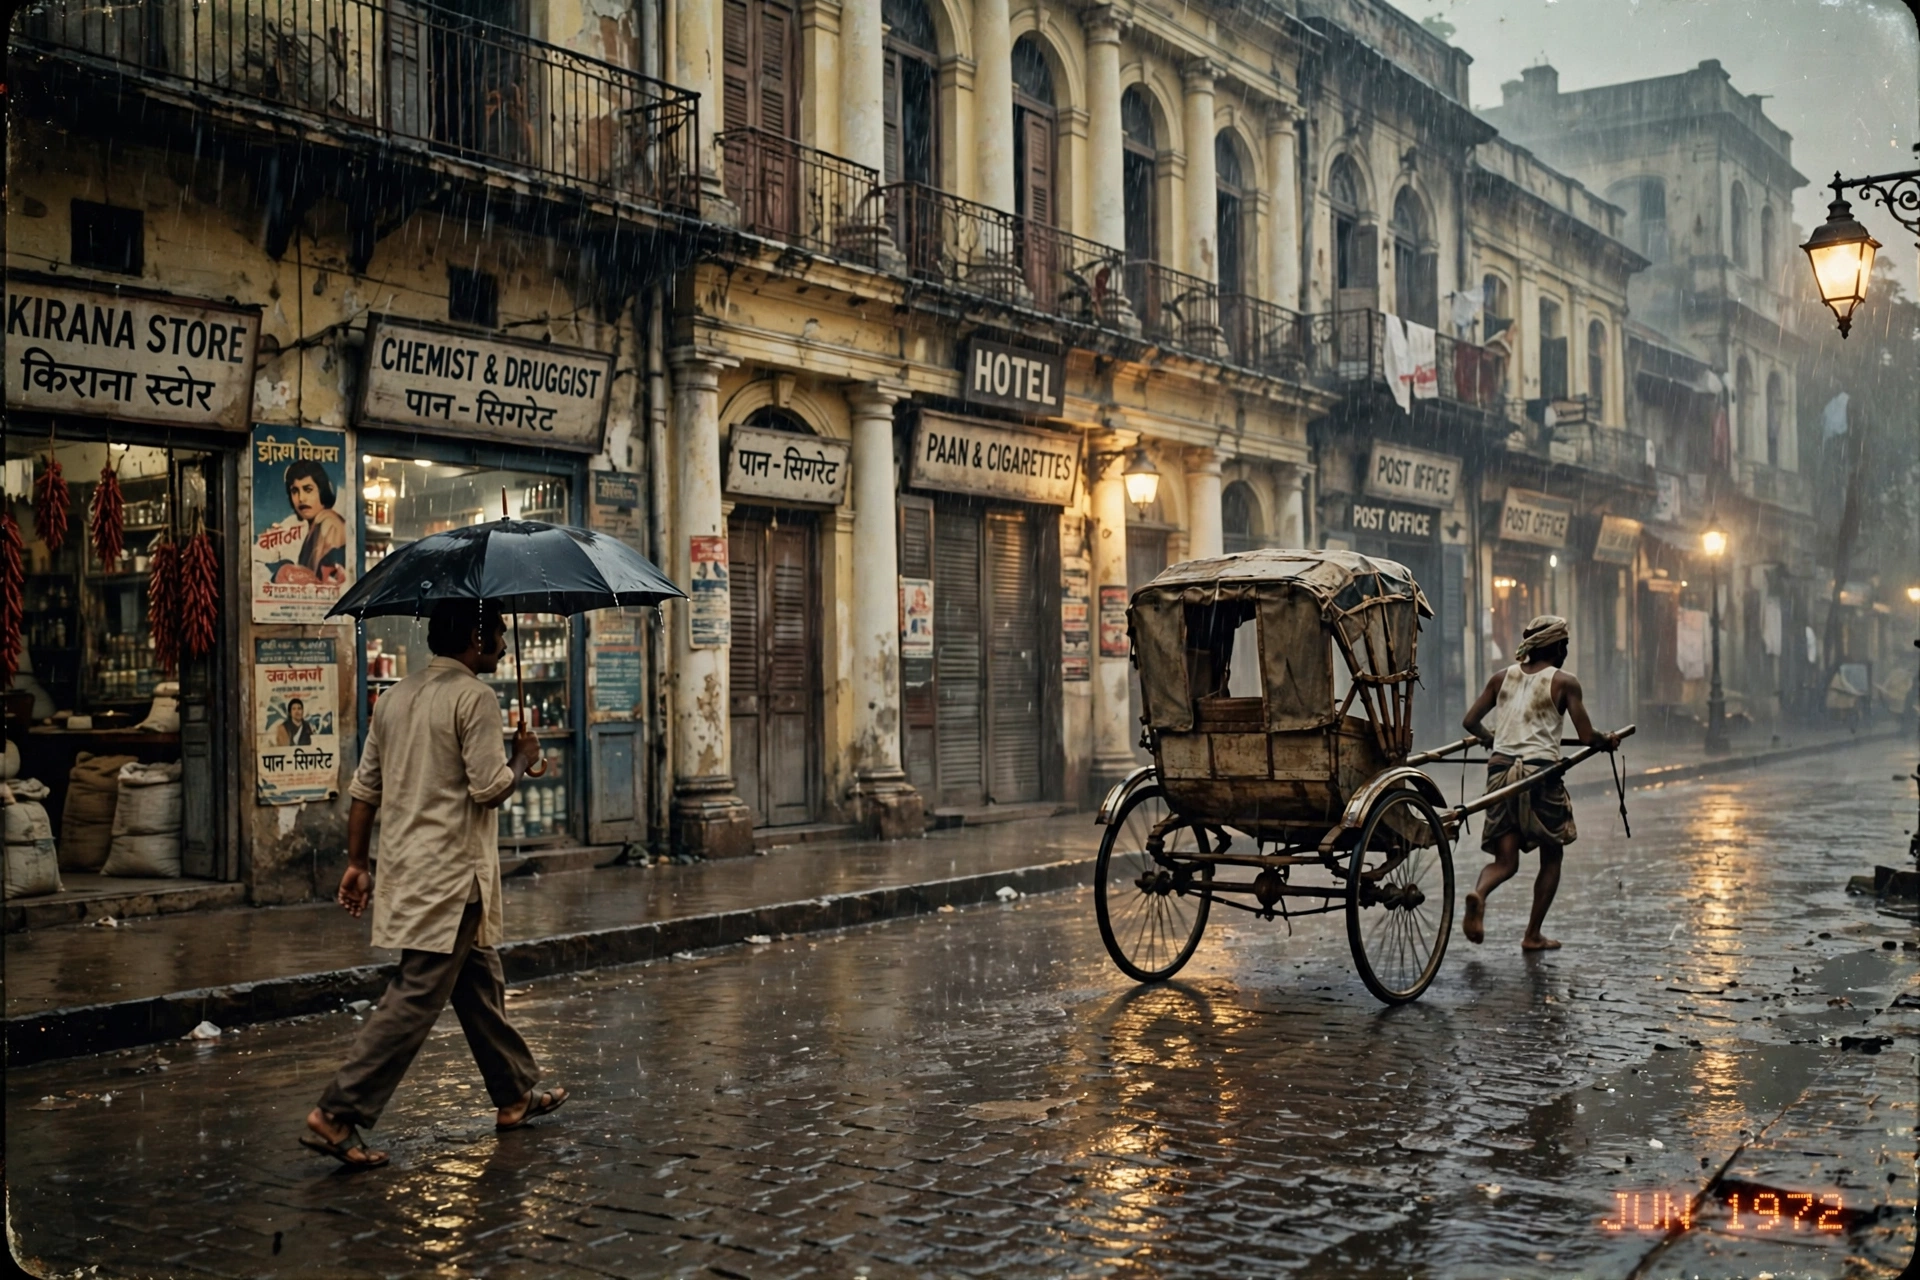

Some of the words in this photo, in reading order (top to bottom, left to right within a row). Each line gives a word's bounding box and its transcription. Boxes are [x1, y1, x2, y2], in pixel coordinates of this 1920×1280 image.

[7, 294, 136, 350] KIRANA
[146, 314, 247, 364] STORE
[20, 346, 137, 402] किराना
[146, 365, 216, 412] स्टोर
[381, 337, 479, 382] CHEMIST
[483, 353, 499, 385] &
[504, 356, 601, 399] DRUGGIST
[974, 348, 1057, 406] HOTEL
[926, 432, 969, 468] PAAN
[972, 441, 983, 469] &
[987, 442, 1072, 481] CIGARETTES
[1377, 455, 1411, 487] POST
[1413, 463, 1450, 495] OFFICE
[1353, 504, 1385, 531] POST
[1388, 510, 1431, 536] OFFICE
[1505, 506, 1531, 531] POST
[1533, 512, 1566, 538] OFFICE
